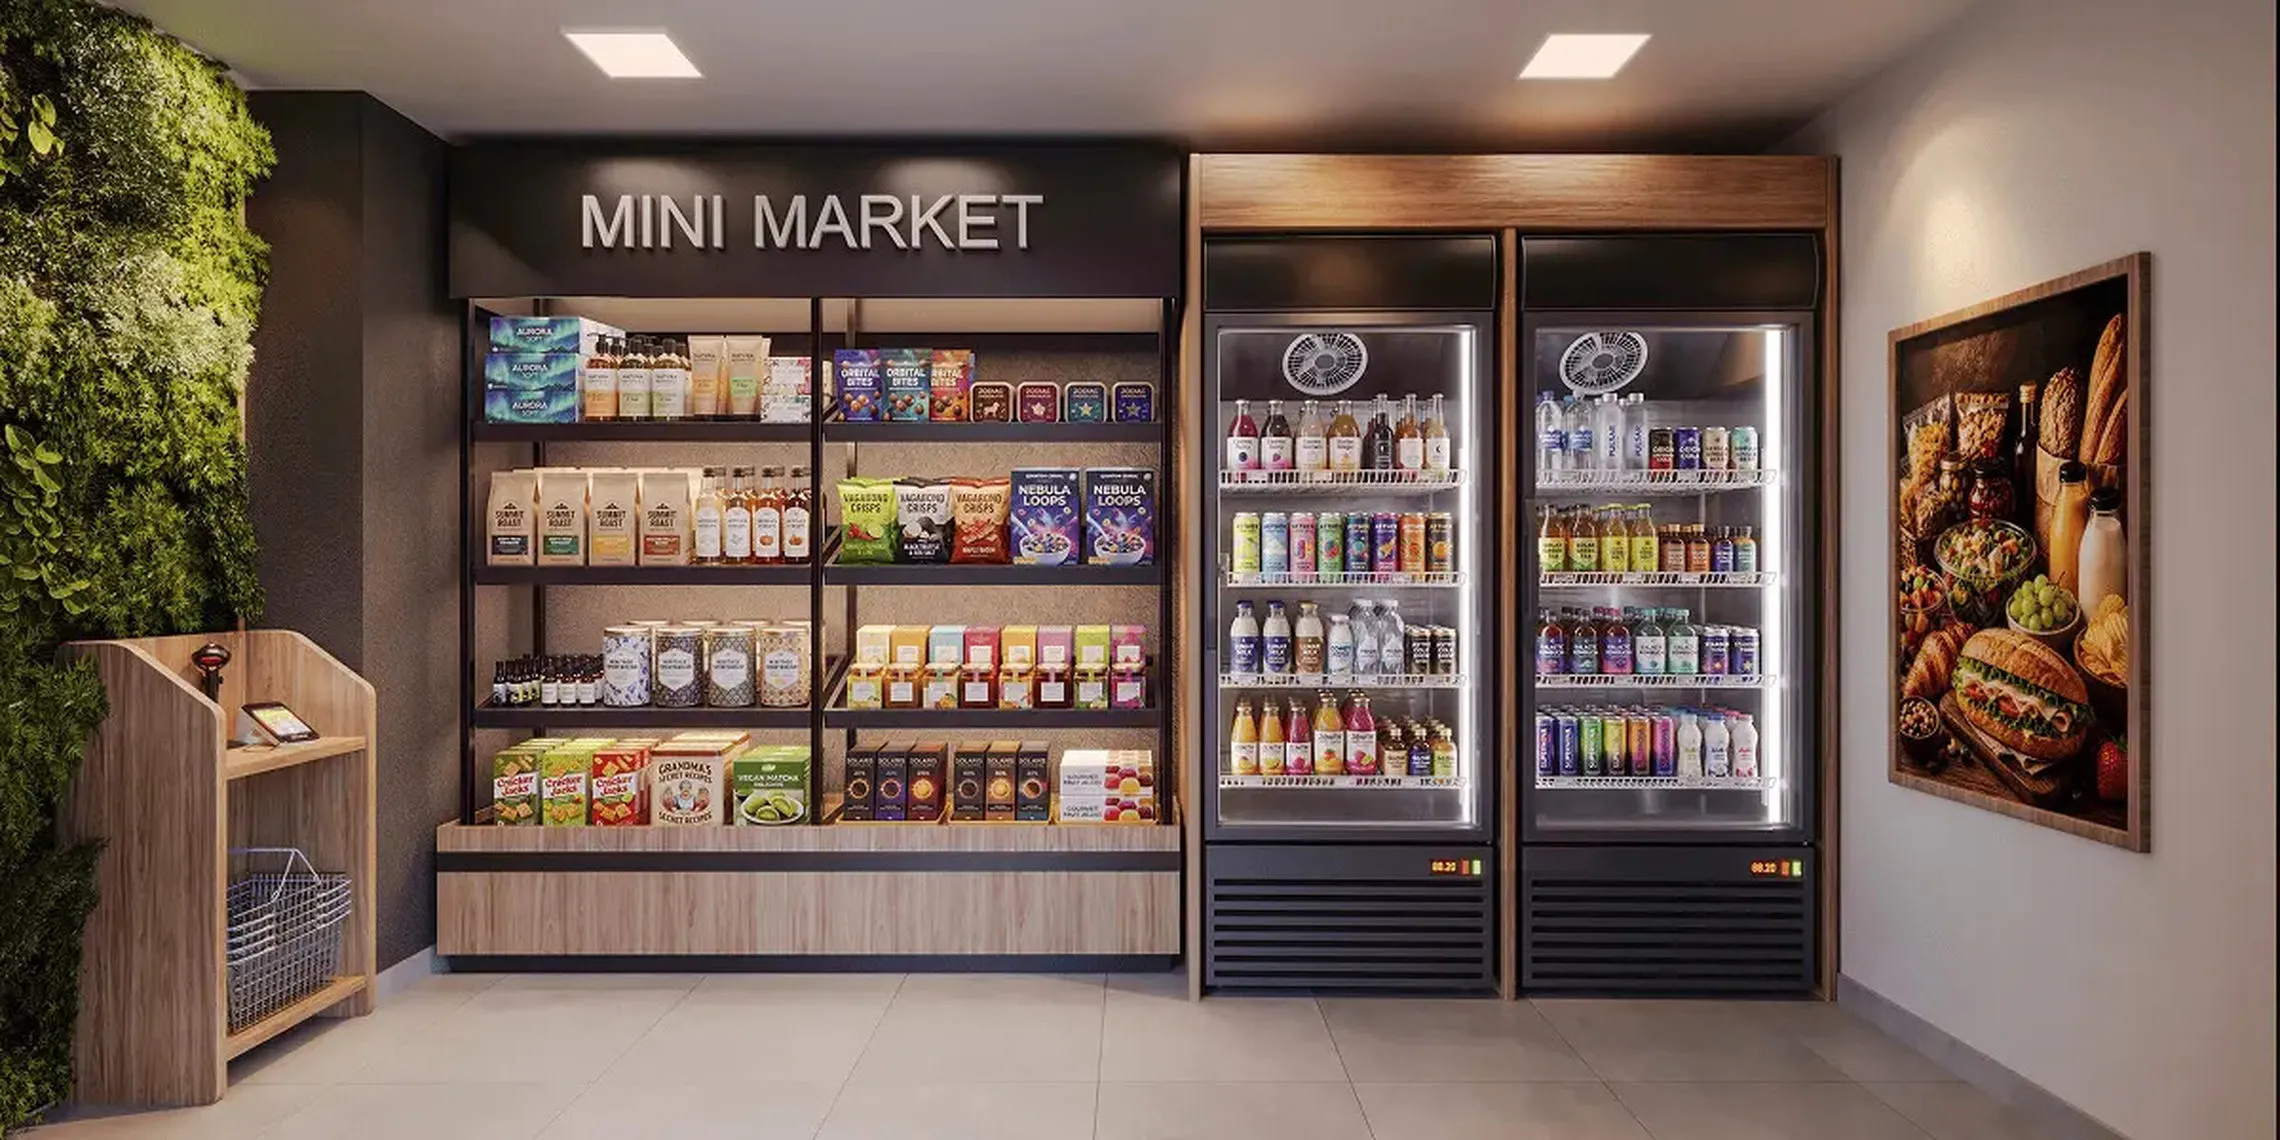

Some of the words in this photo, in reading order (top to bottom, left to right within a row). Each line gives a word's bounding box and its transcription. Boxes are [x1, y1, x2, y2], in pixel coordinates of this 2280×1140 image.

[582, 195, 725, 249] MINI
[754, 195, 1044, 249] MARKET
[841, 368, 881, 378] ORBITAL
[886, 368, 926, 378] ORBITAL
[931, 368, 964, 379] RBITAL
[847, 378, 872, 387] BITES
[892, 378, 919, 387] BITES
[1608, 424, 1616, 457] PULSAR
[1634, 424, 1642, 457] PULSAR
[1018, 485, 1071, 495] NEBULA
[1093, 485, 1146, 495] NEBULA
[900, 493, 945, 502] VAGABOND
[956, 493, 1002, 502] VAGABOND
[1023, 495, 1067, 506] LOOPS
[1098, 495, 1141, 506] LOOPS
[850, 503, 881, 513] CRISPS
[907, 503, 937, 513] CRISPS
[964, 503, 994, 513] CRISPS
[659, 761, 712, 775] GRANDMA'S
[496, 776, 534, 787] Cracker
[544, 776, 582, 787] Cracker
[596, 775, 633, 788] Cracker
[658, 811, 684, 824] SECRET
